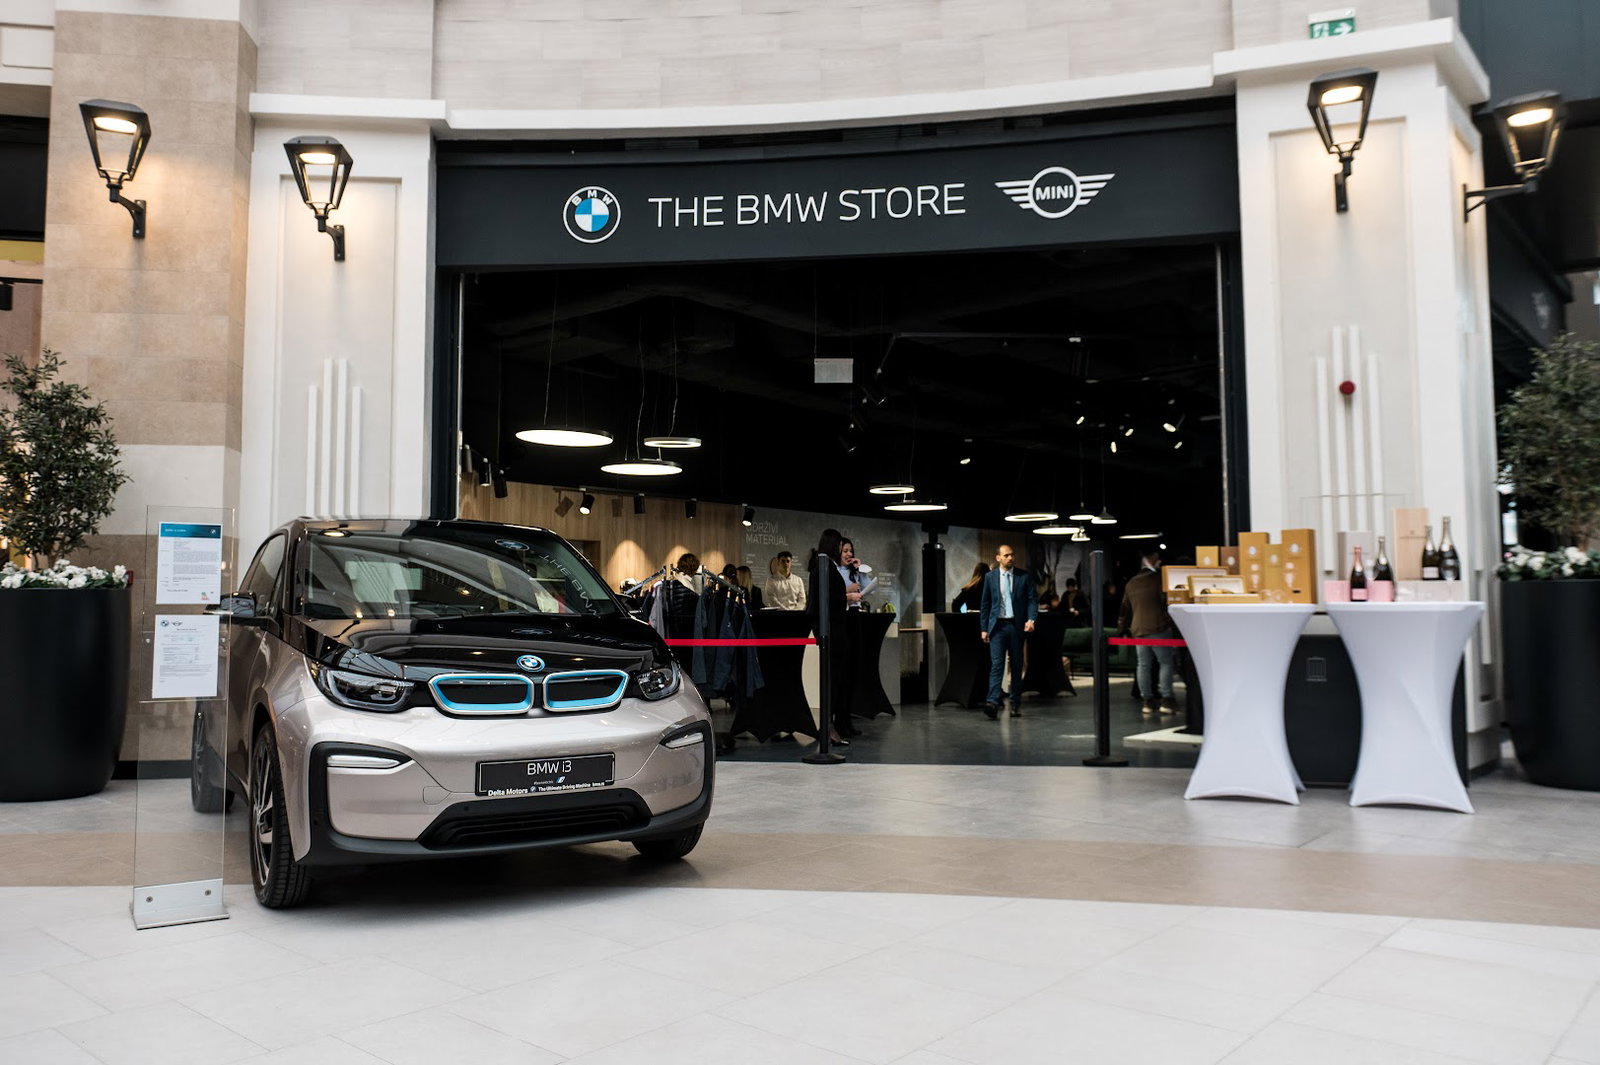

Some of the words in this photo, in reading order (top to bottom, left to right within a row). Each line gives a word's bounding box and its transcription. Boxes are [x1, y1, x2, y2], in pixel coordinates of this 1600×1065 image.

[571, 189, 613, 206] BMW
[1035, 184, 1074, 201] MINI
[648, 195, 724, 227] THE
[736, 192, 828, 225] BMW
[838, 183, 966, 221] STORE
[745, 533, 789, 546] MATERIJAL
[527, 761, 560, 776] BMW
[562, 759, 572, 773] i3
[487, 789, 505, 797] Delta
[506, 787, 528, 796] Motors
